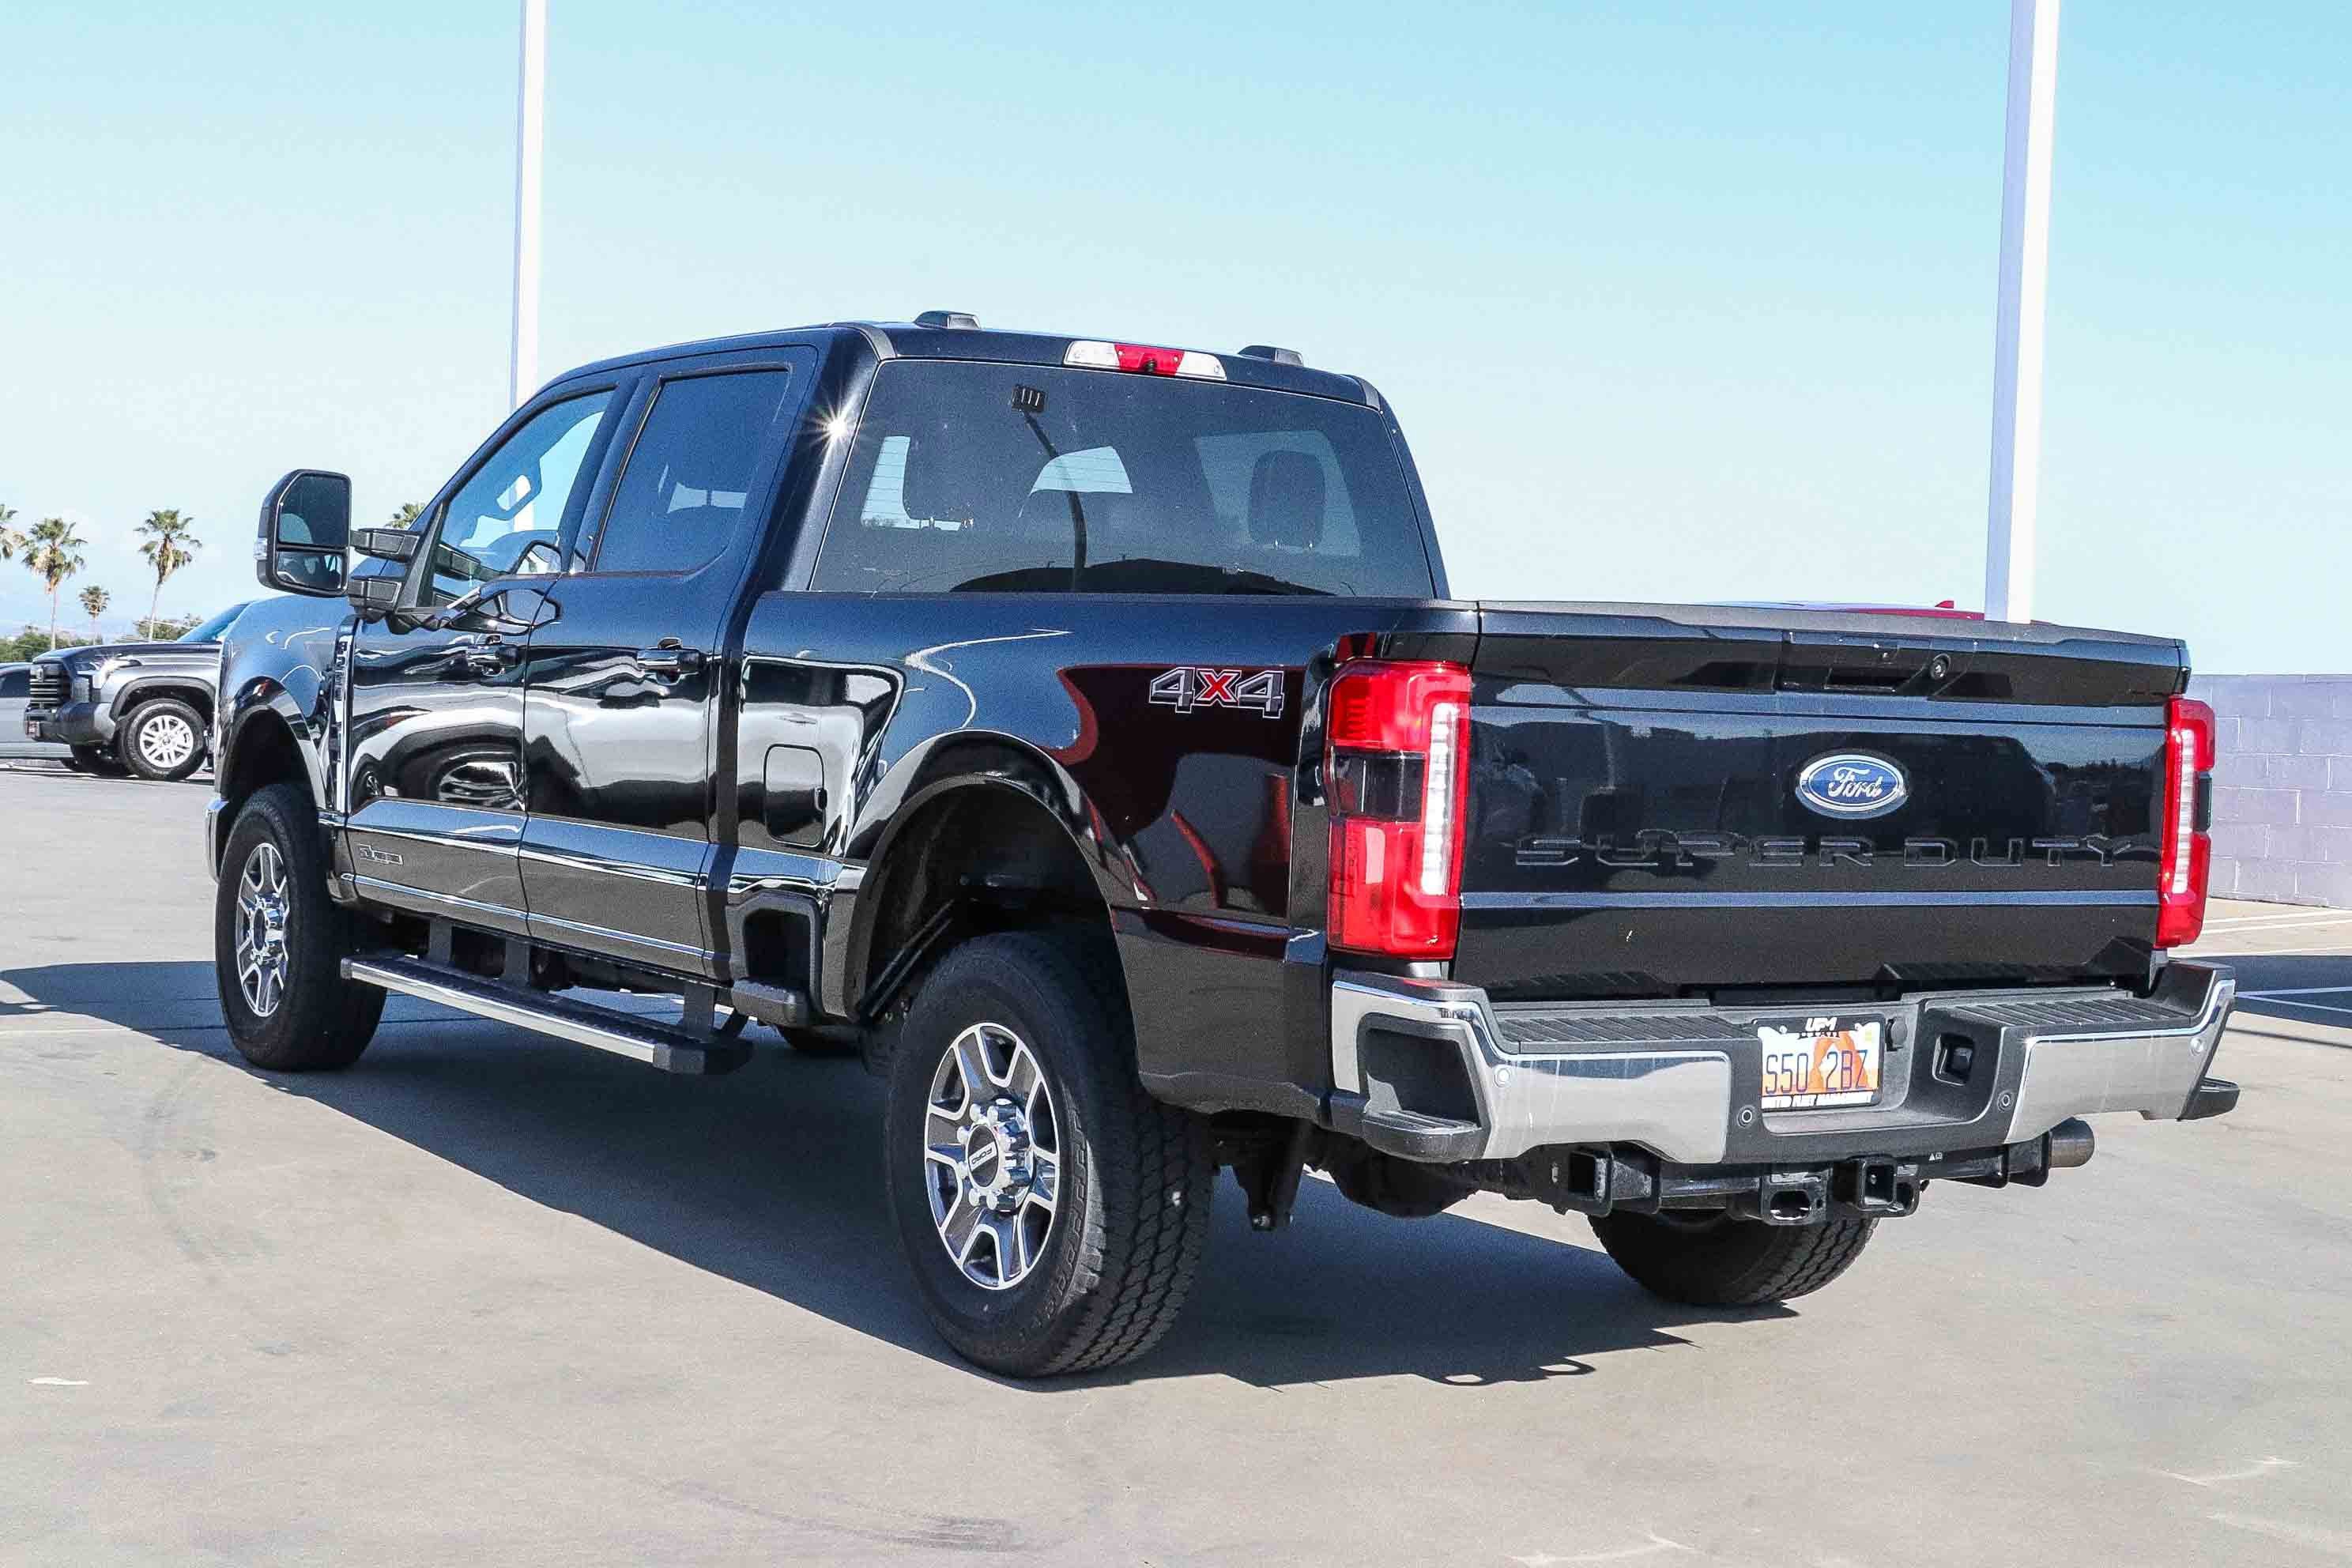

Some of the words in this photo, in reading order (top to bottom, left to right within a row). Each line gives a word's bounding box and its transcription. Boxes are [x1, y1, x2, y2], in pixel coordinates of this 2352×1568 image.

[1828, 767, 1884, 797] Ford
[1515, 833, 1872, 867] SUPER
[1903, 835, 2132, 867] DUTY
